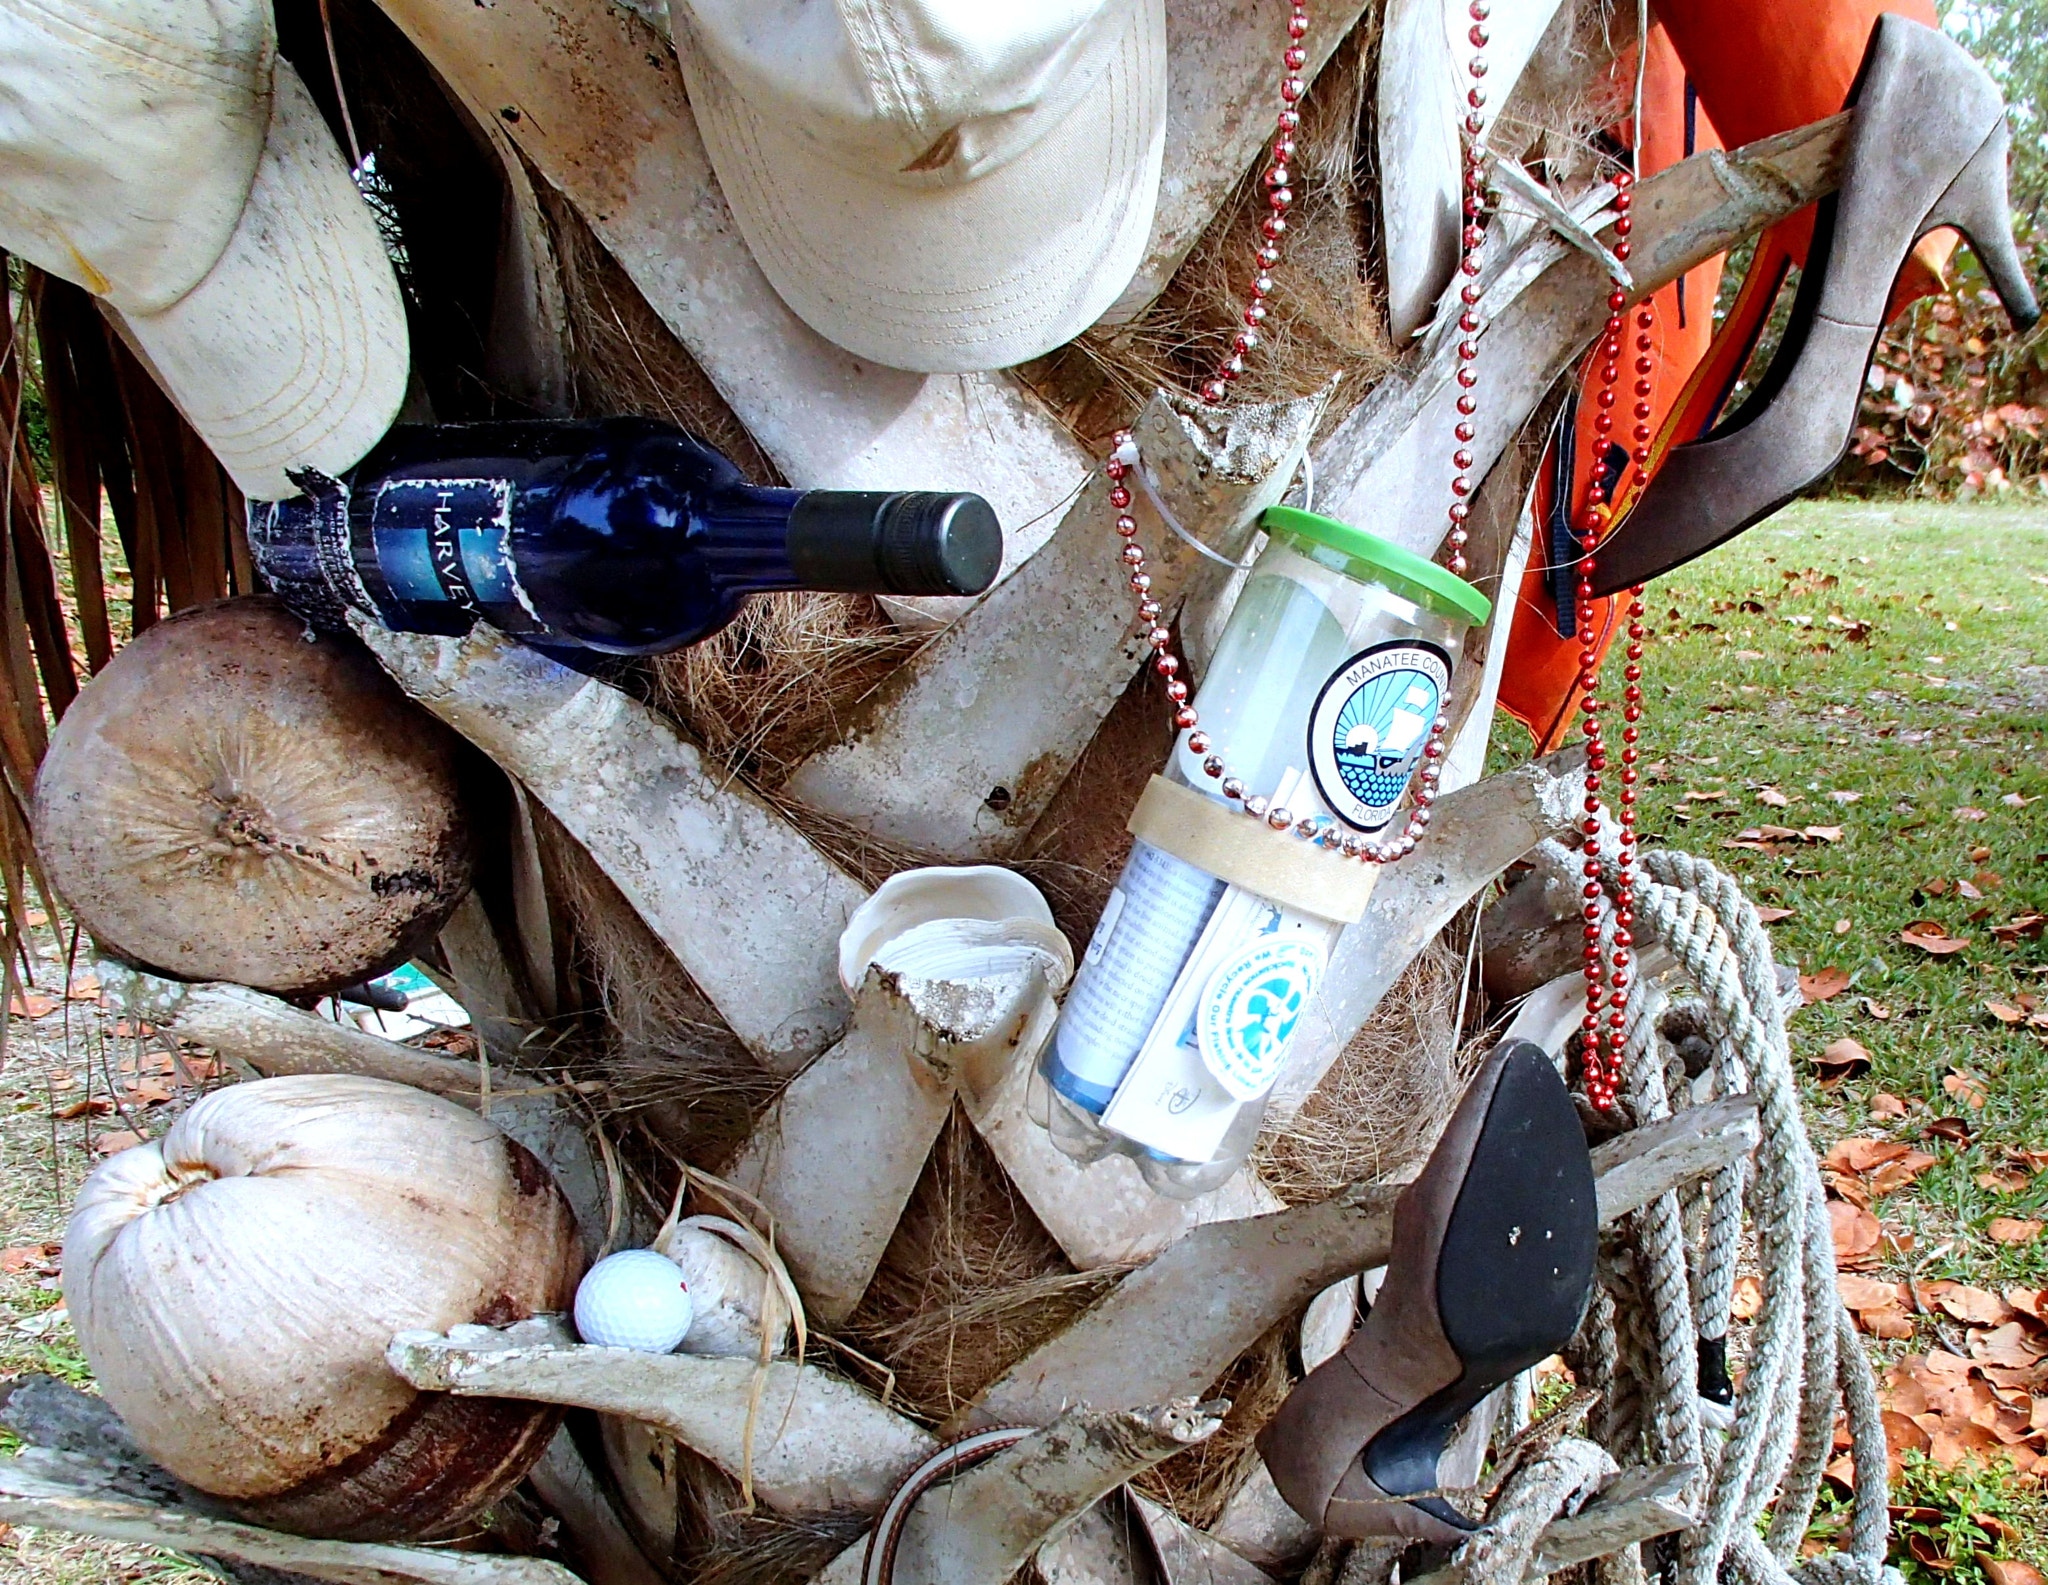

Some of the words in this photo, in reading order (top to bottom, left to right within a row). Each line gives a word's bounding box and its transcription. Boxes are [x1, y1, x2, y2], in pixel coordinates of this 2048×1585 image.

[434, 491, 482, 622] HARVEY
[1346, 653, 1420, 687] MANATEE
[1351, 803, 1391, 822] FLORIDA
[1254, 950, 1273, 962] We
[1215, 959, 1253, 1001] Recycle
[1209, 1004, 1221, 1027] Our
